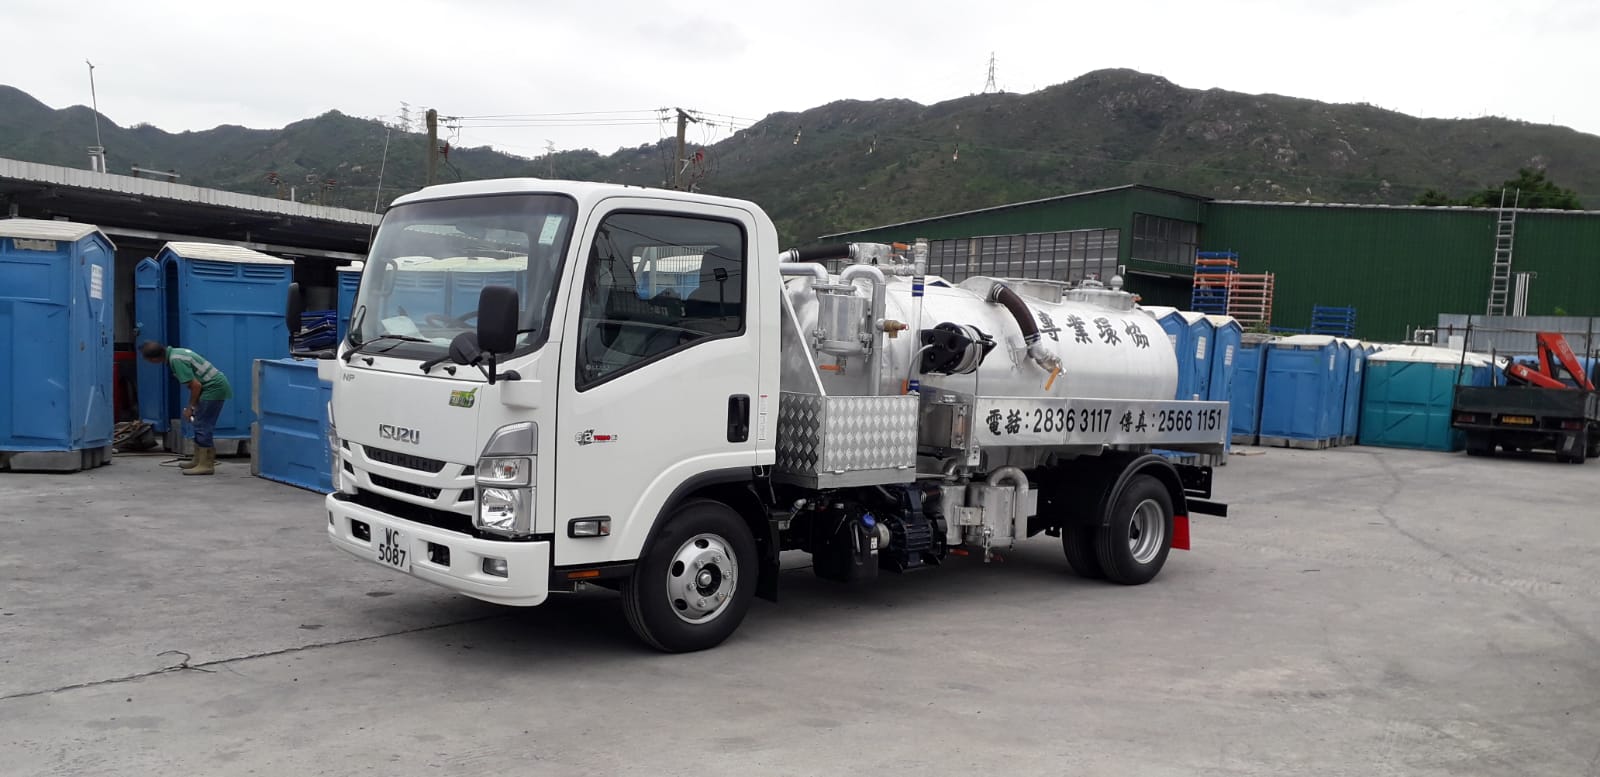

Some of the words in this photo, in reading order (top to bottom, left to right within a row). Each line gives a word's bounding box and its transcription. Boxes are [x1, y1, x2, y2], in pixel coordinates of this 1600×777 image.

[1080, 408, 1112, 433] 3117
[379, 423, 420, 445] ISUZU
[385, 528, 400, 548] WC
[378, 543, 406, 567] 5087
